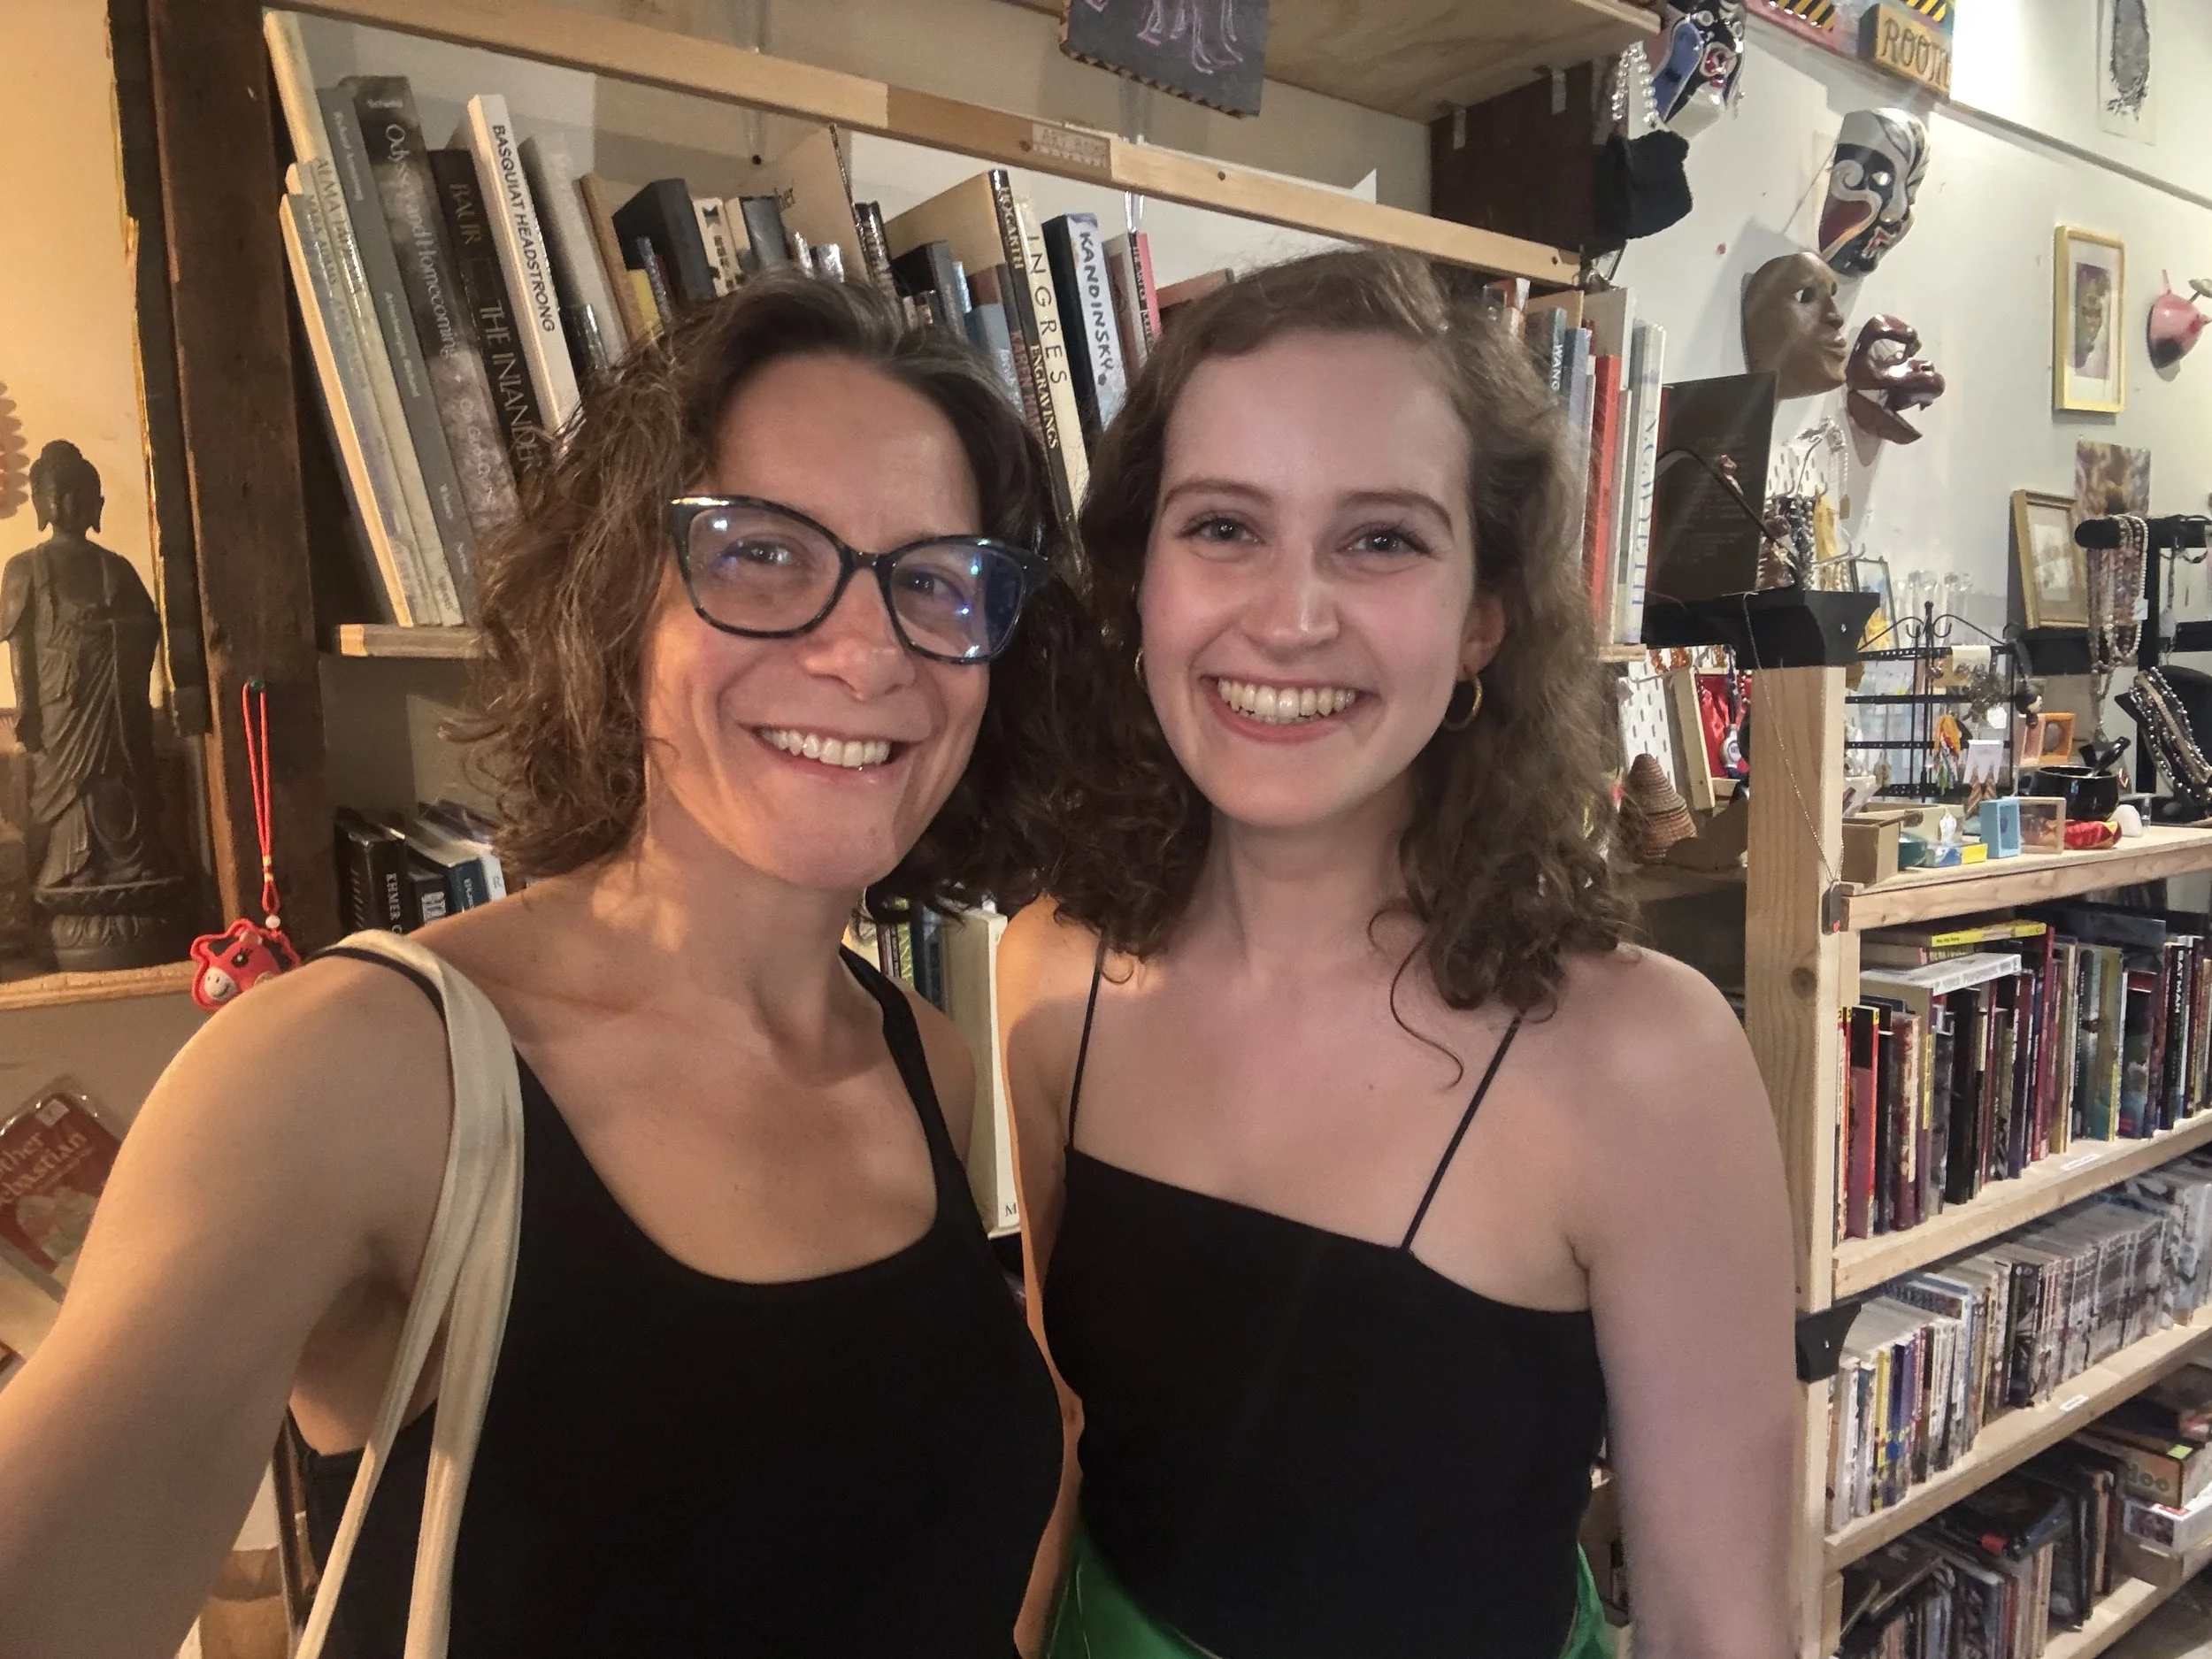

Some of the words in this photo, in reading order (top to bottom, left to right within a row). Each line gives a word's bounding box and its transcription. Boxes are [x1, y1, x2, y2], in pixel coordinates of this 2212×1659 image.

[384, 123, 419, 201] Odyssey
[405, 202, 428, 237] and
[492, 125, 525, 210] BASQUIAT
[516, 214, 557, 333] HEADSTRONG
[416, 239, 459, 358] Homecoming
[480, 301, 511, 345] THE
[999, 188, 1024, 270] HOGARTH
[1031, 345, 1059, 449] ENGRAVINGS
[1026, 234, 1067, 384] INGRES
[1079, 230, 1114, 371] KANDINSKY
[491, 350, 543, 471] INLANDER
[2174, 949, 2185, 1014] BATMAN
